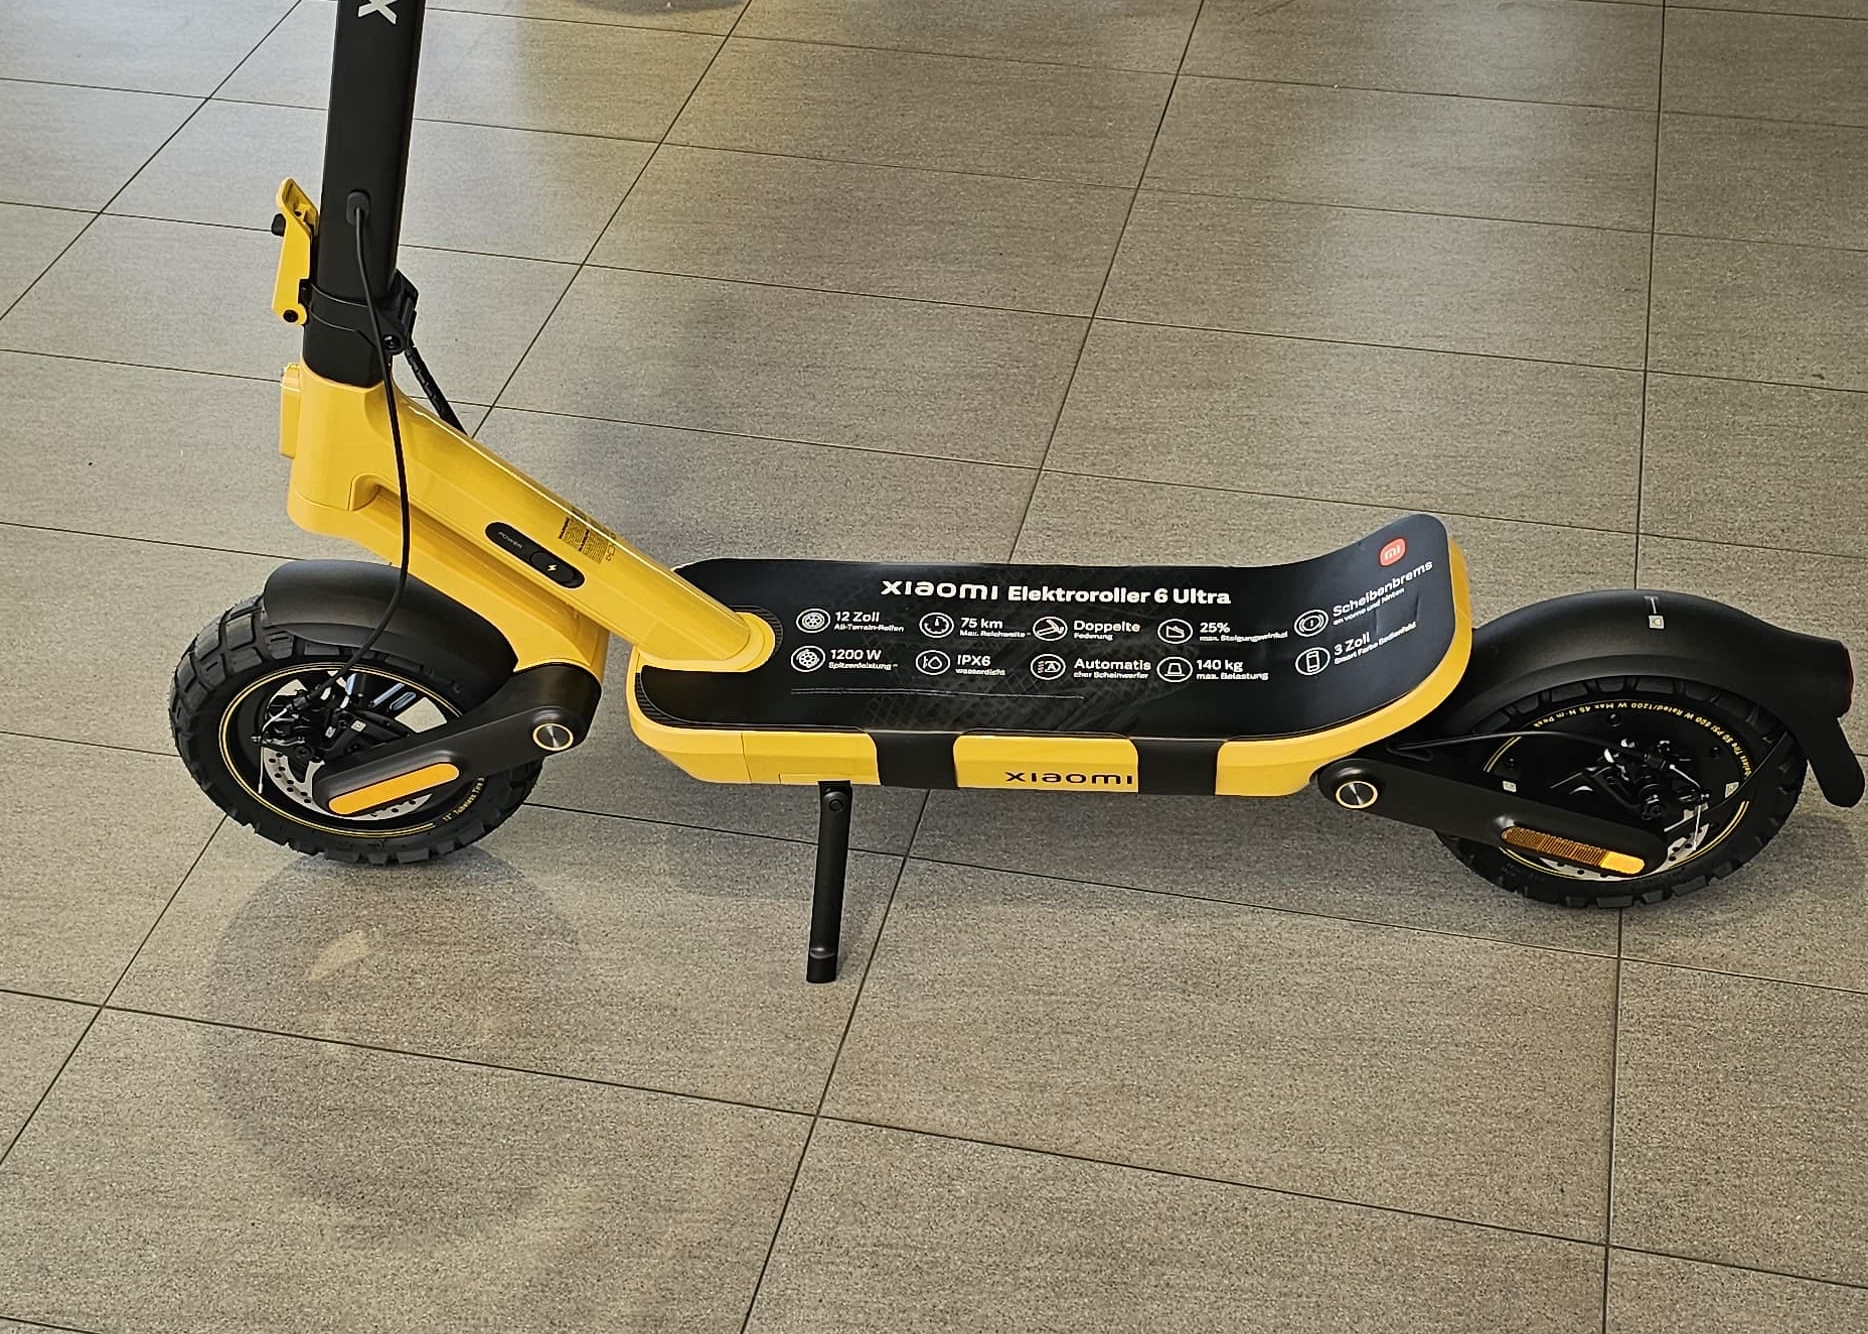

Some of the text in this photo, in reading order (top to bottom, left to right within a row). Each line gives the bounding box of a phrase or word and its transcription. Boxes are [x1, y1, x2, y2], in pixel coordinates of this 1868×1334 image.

[1007, 585, 1151, 604] Elektroroller
[1154, 588, 1168, 604] 6
[1172, 588, 1232, 605] Ultra
[835, 611, 881, 623] 12 Zoll
[960, 617, 1004, 629] 75 km
[1073, 620, 1142, 634] Doppelte
[1199, 622, 1231, 634] 25%
[1073, 632, 1114, 642] Federung
[1334, 631, 1371, 656] 3 Zoll
[830, 648, 882, 661] 1200 W
[957, 654, 991, 667] IPX6
[1073, 657, 1152, 671] Automatis
[1196, 659, 1244, 673] 140 kg
